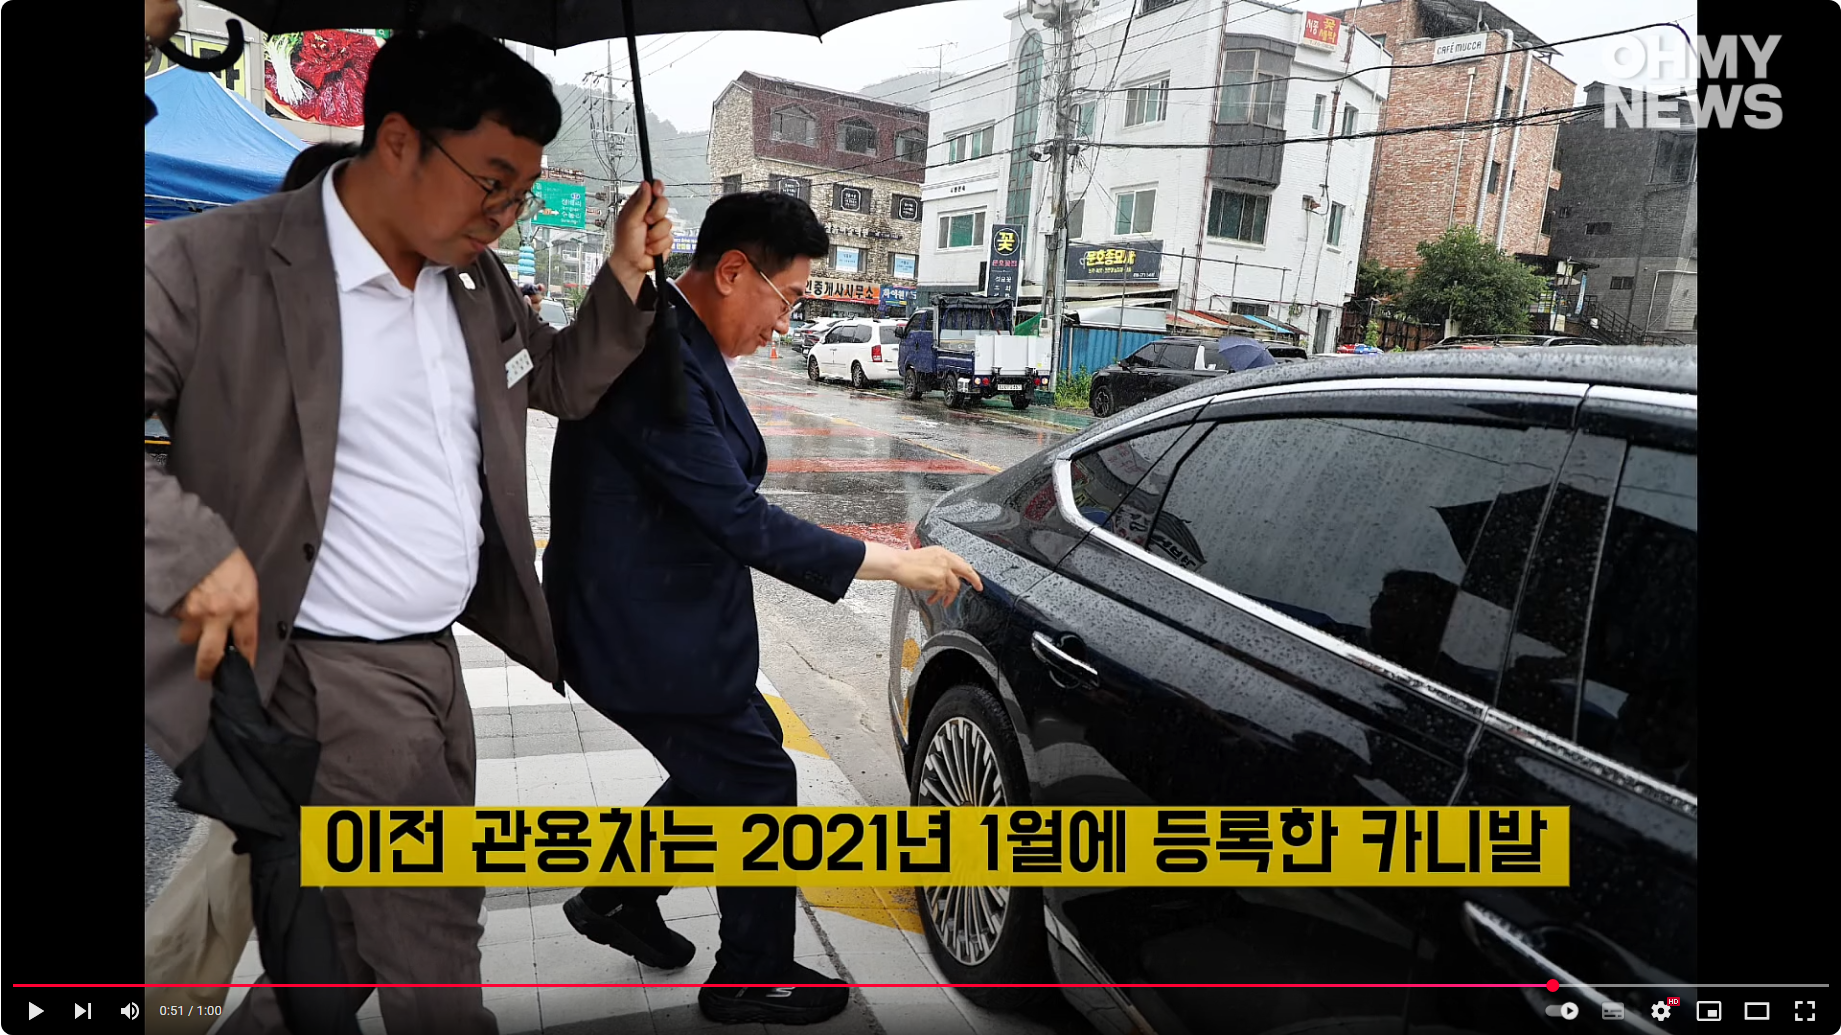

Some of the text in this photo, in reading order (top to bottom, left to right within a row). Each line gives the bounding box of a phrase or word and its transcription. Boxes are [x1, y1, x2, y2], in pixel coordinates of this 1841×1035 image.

[1436, 40, 1482, 54] CAFÉ MUCCA
[996, 231, 1016, 252] 꽃
